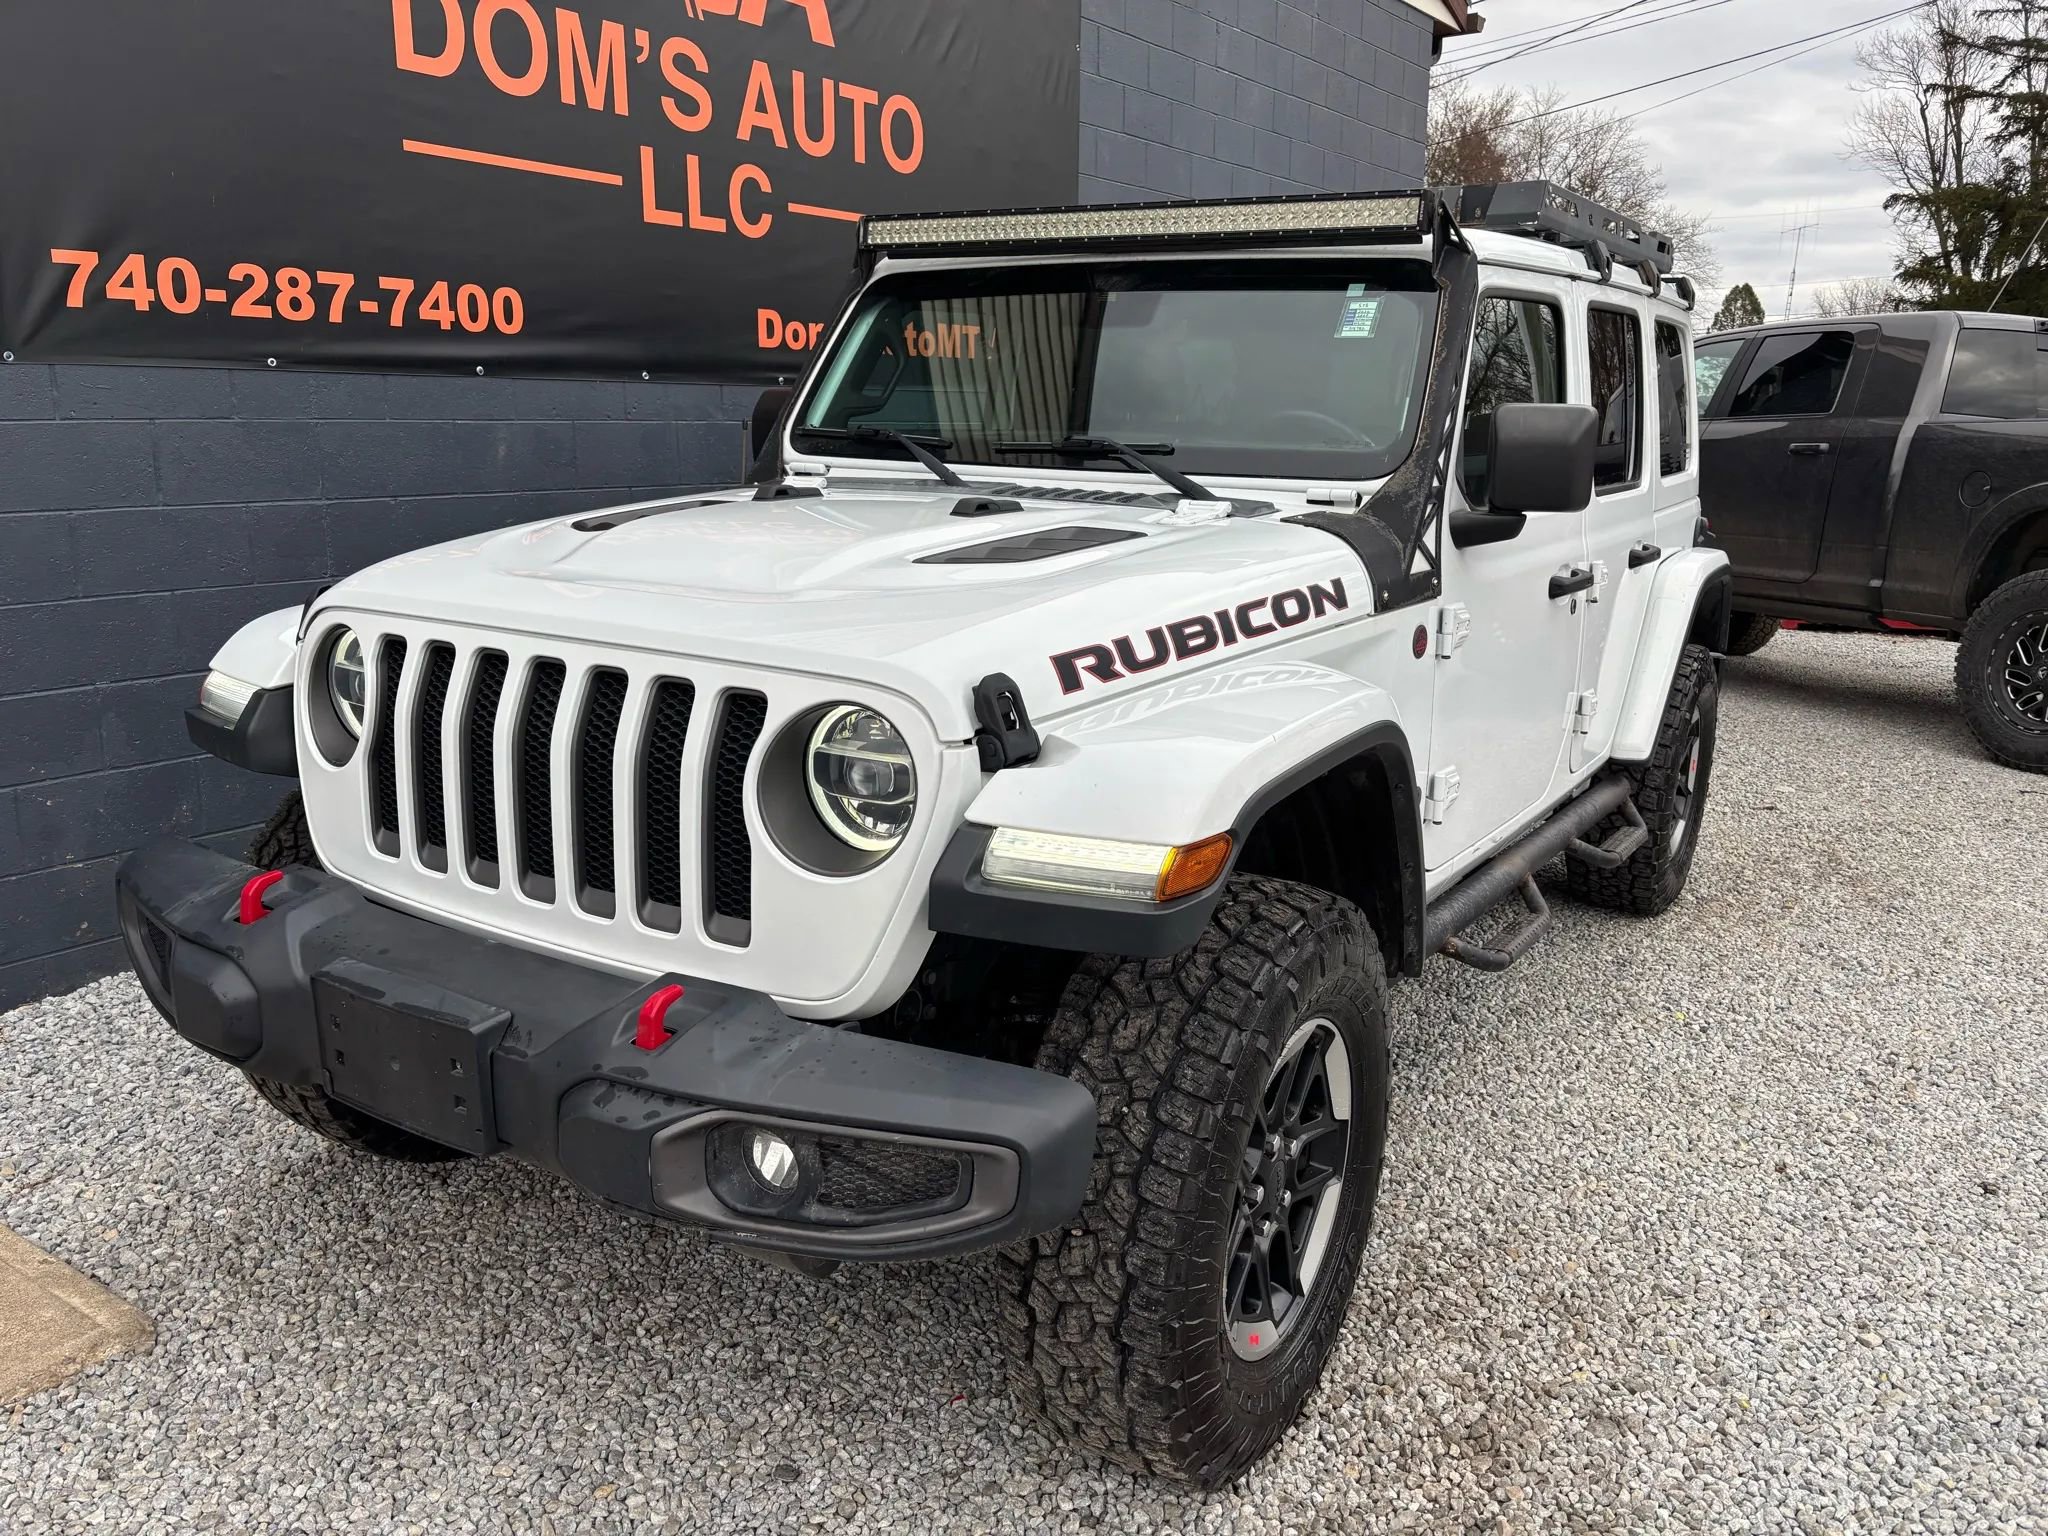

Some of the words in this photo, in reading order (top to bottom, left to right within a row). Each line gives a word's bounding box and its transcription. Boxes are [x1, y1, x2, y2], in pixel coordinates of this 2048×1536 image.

[391, 0, 714, 133] DOM'S
[736, 60, 925, 174] AUTO
[639, 146, 774, 239] LLC
[51, 249, 525, 336] 740-287-7400
[1049, 577, 1349, 695] RUBICON
